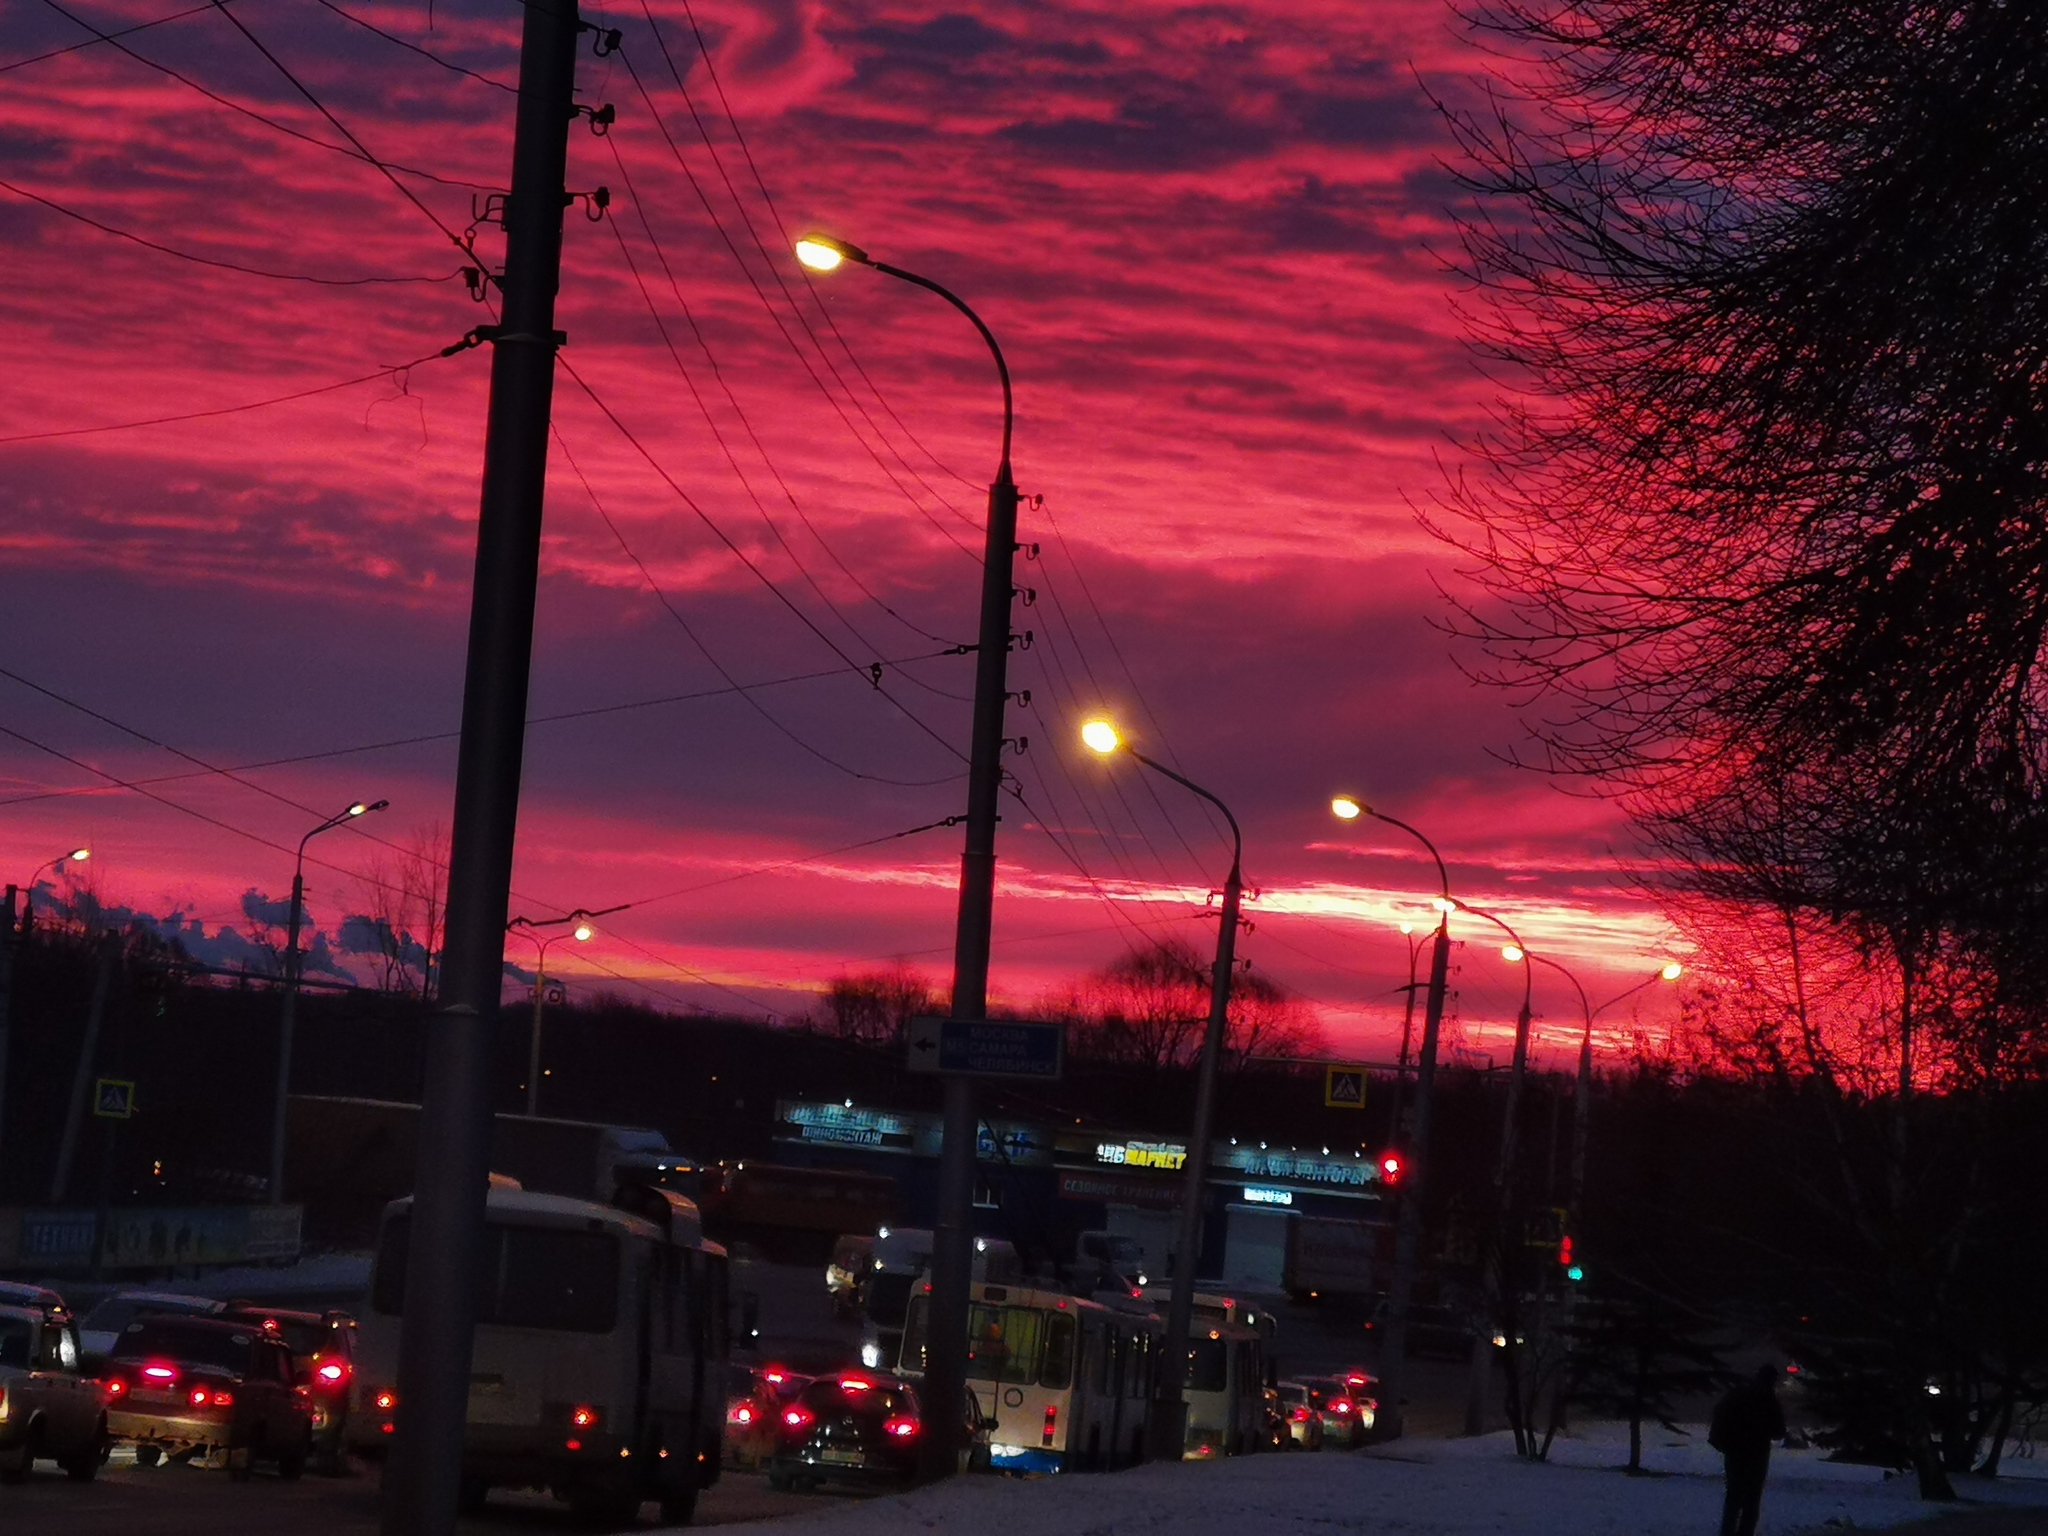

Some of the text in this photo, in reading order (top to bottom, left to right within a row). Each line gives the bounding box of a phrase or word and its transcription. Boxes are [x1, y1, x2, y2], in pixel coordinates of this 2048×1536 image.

[970, 1026, 1029, 1041] МОСКВА
[968, 1040, 1028, 1057] САМАРА
[965, 1055, 1057, 1074] ЧЕЛЯБИНСК
[1124, 1148, 1187, 1170] МАРКЕТ
[1063, 1178, 1119, 1196] СЕЗОННОЕ
